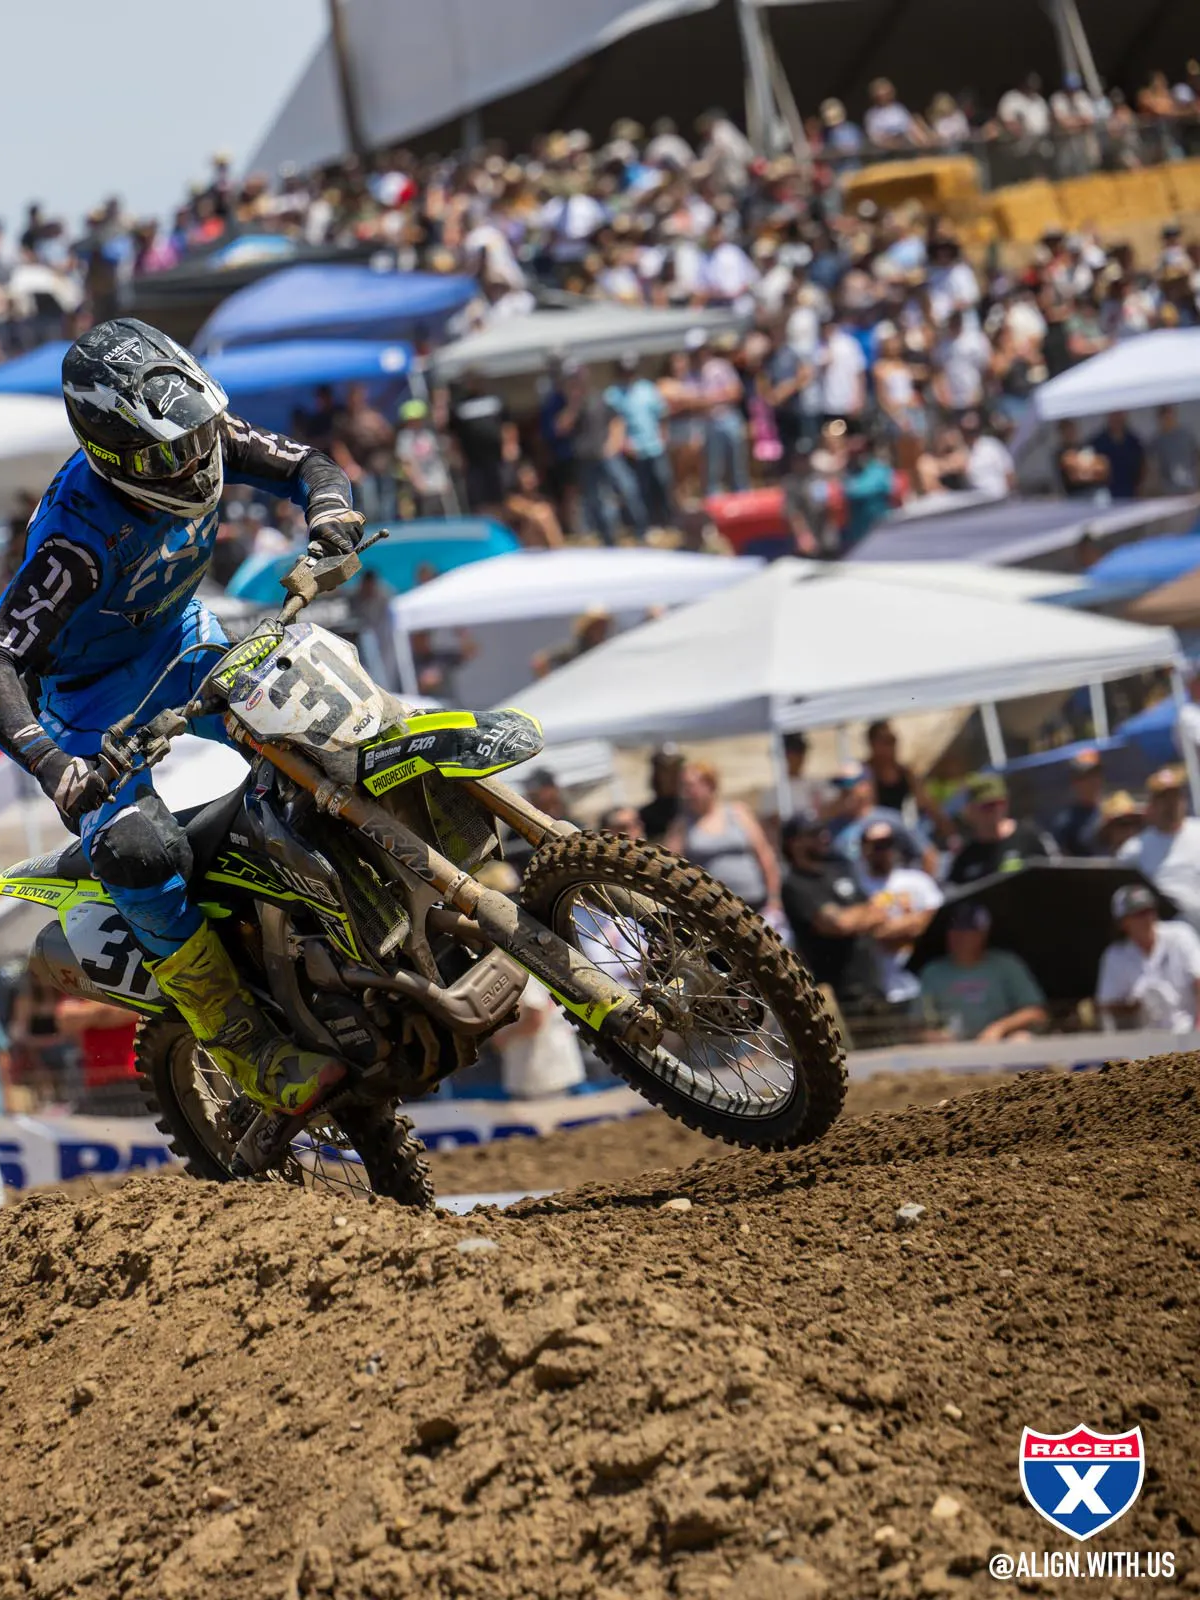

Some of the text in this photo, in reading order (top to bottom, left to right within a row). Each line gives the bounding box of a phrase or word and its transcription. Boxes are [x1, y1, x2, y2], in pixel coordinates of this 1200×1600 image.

[90, 446, 117, 465] 100%
[269, 640, 374, 746] 31
[407, 735, 437, 753] FXR
[372, 760, 417, 792] PROGRESSIVE
[17, 886, 61, 901] DUNLOP
